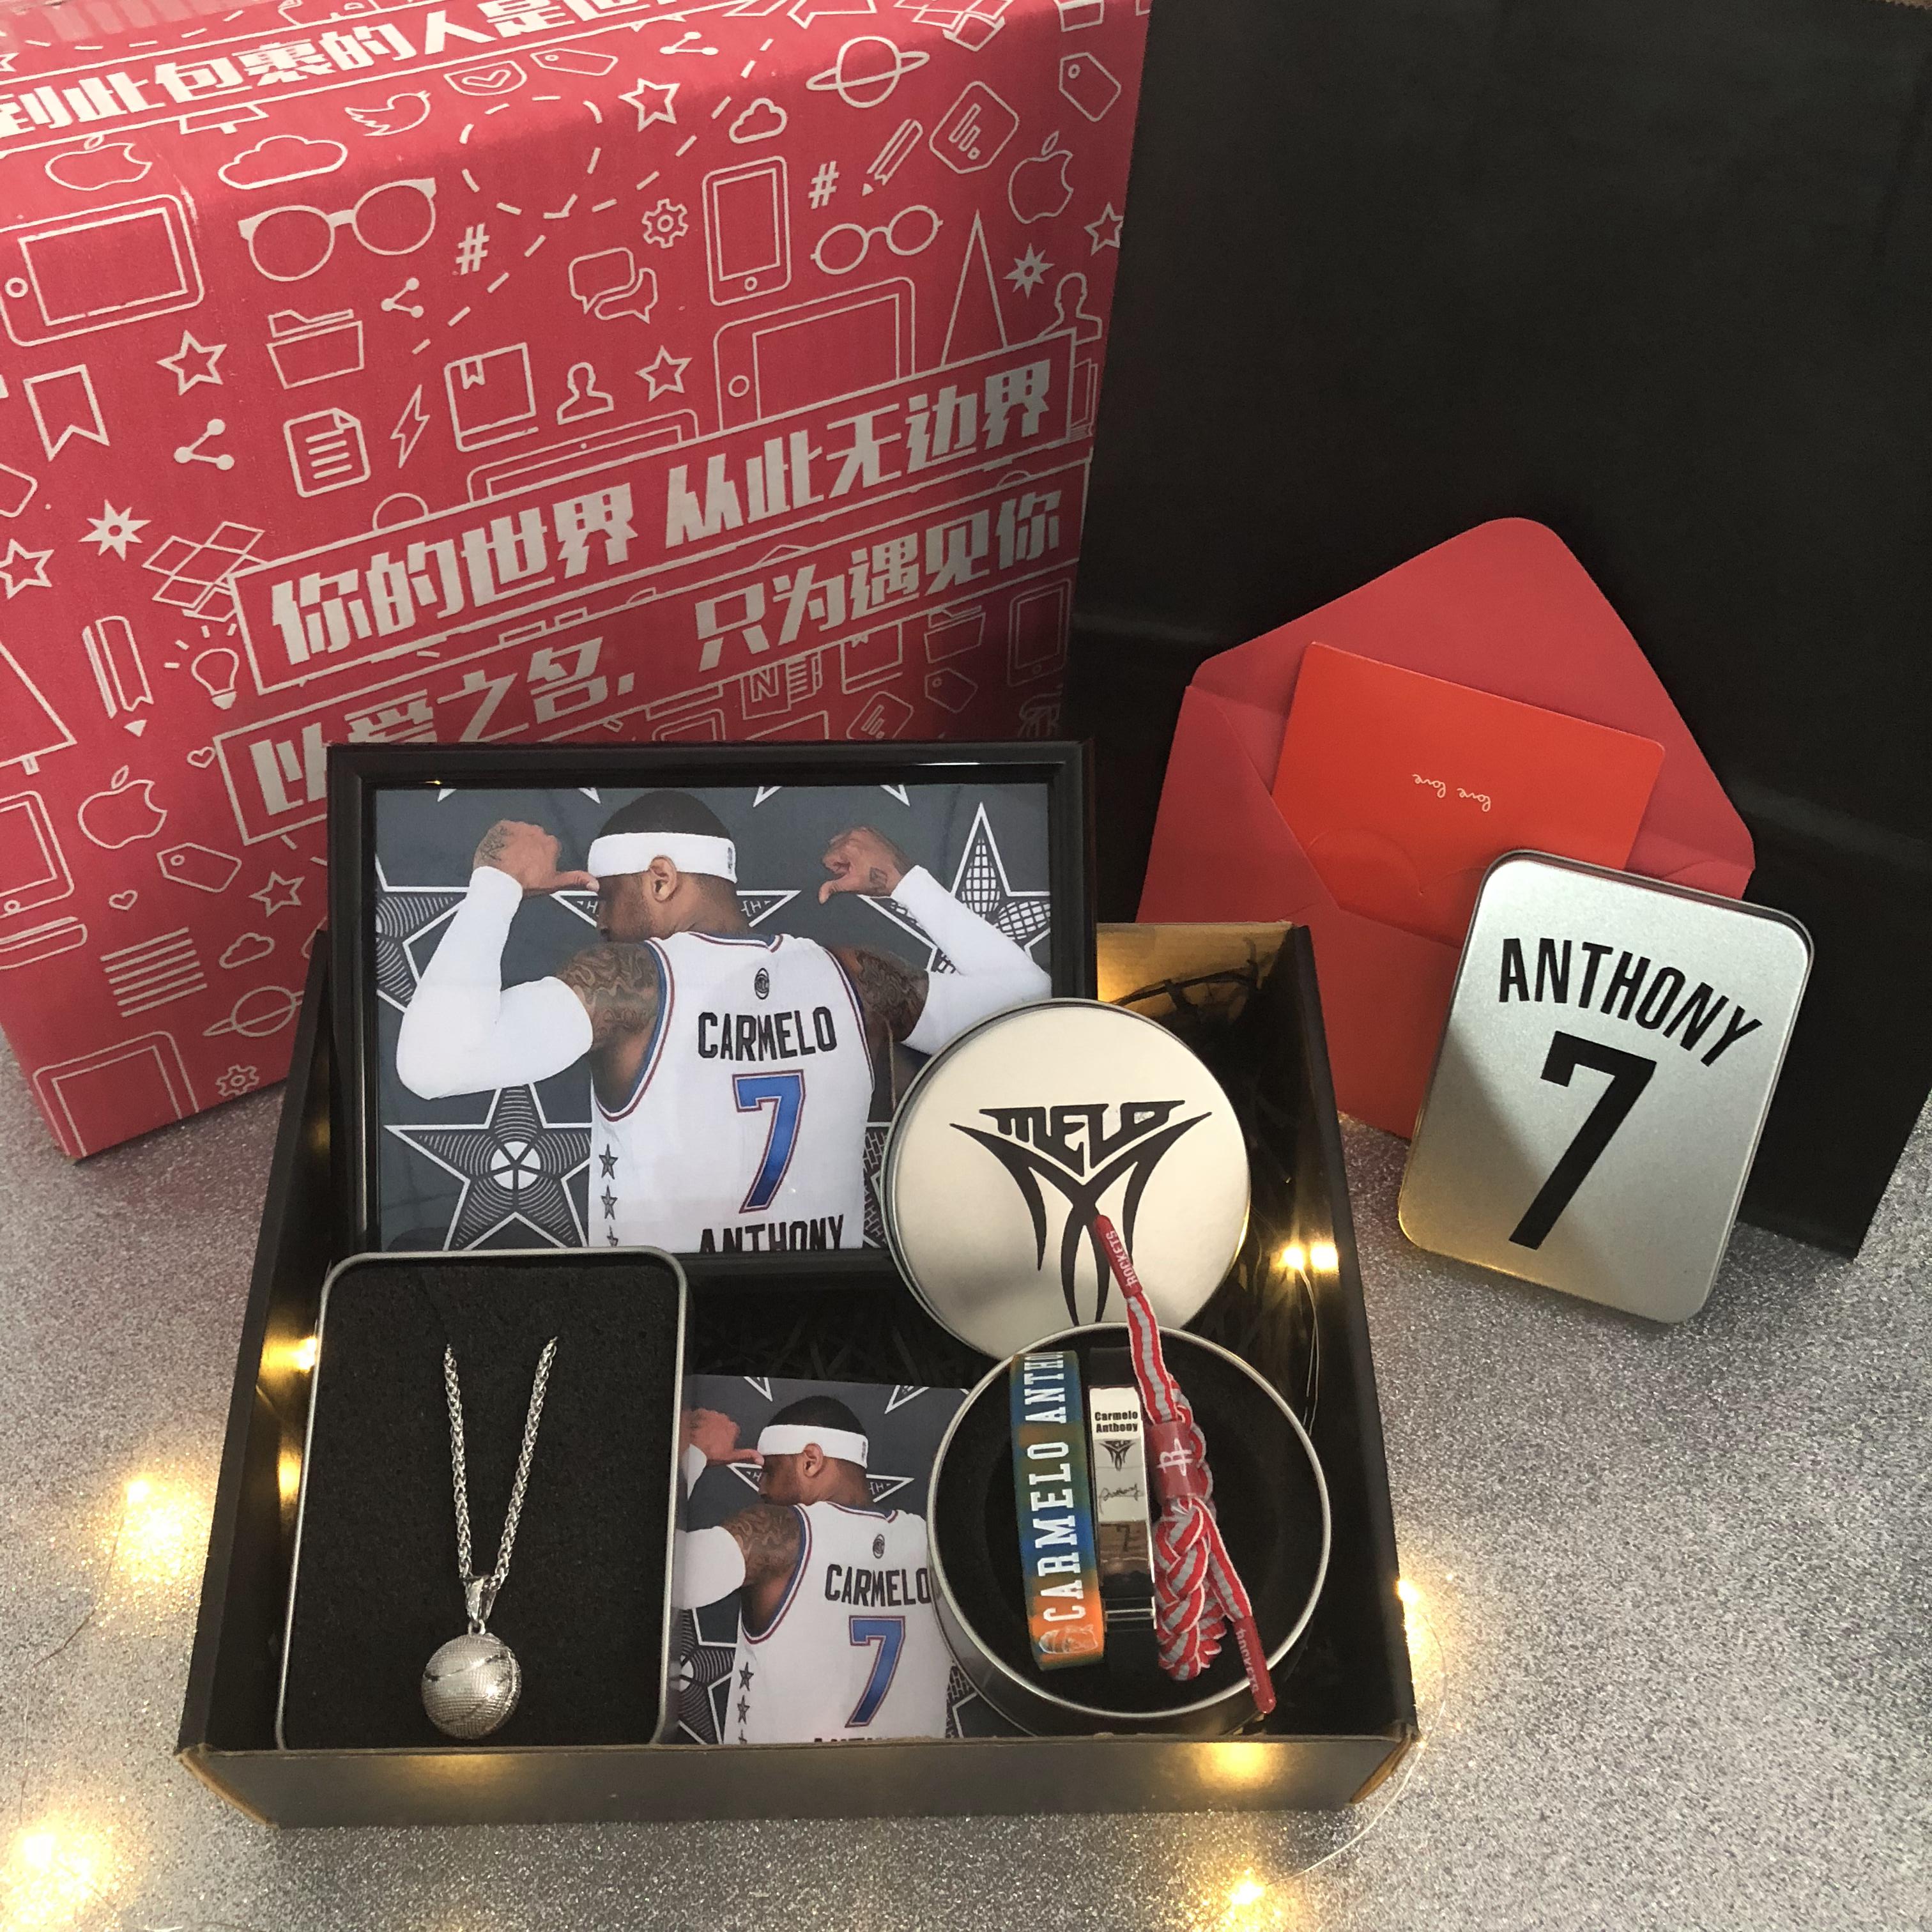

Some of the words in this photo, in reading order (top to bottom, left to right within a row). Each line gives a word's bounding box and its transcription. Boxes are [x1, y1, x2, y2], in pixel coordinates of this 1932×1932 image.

[272, 483, 638, 665] 你的世界
[665, 358, 1051, 549] 从此无边界
[696, 490, 1061, 672] 只为遇见你
[1411, 774, 1446, 798] love
[1457, 788, 1491, 812] love
[698, 1006, 837, 1061] CARMELO
[1499, 937, 1763, 1067] ANTHONY
[732, 1069, 806, 1214] 7
[1509, 1031, 1657, 1250] 7
[1106, 1230, 1138, 1288] ROCKETS
[1094, 1410, 1138, 1421] Carmelo
[1096, 1422, 1138, 1433] Anthony
[1026, 1441, 1085, 1621] CARMELO
[824, 1564, 931, 1607] CARMELO
[845, 1615, 905, 1728] 7
